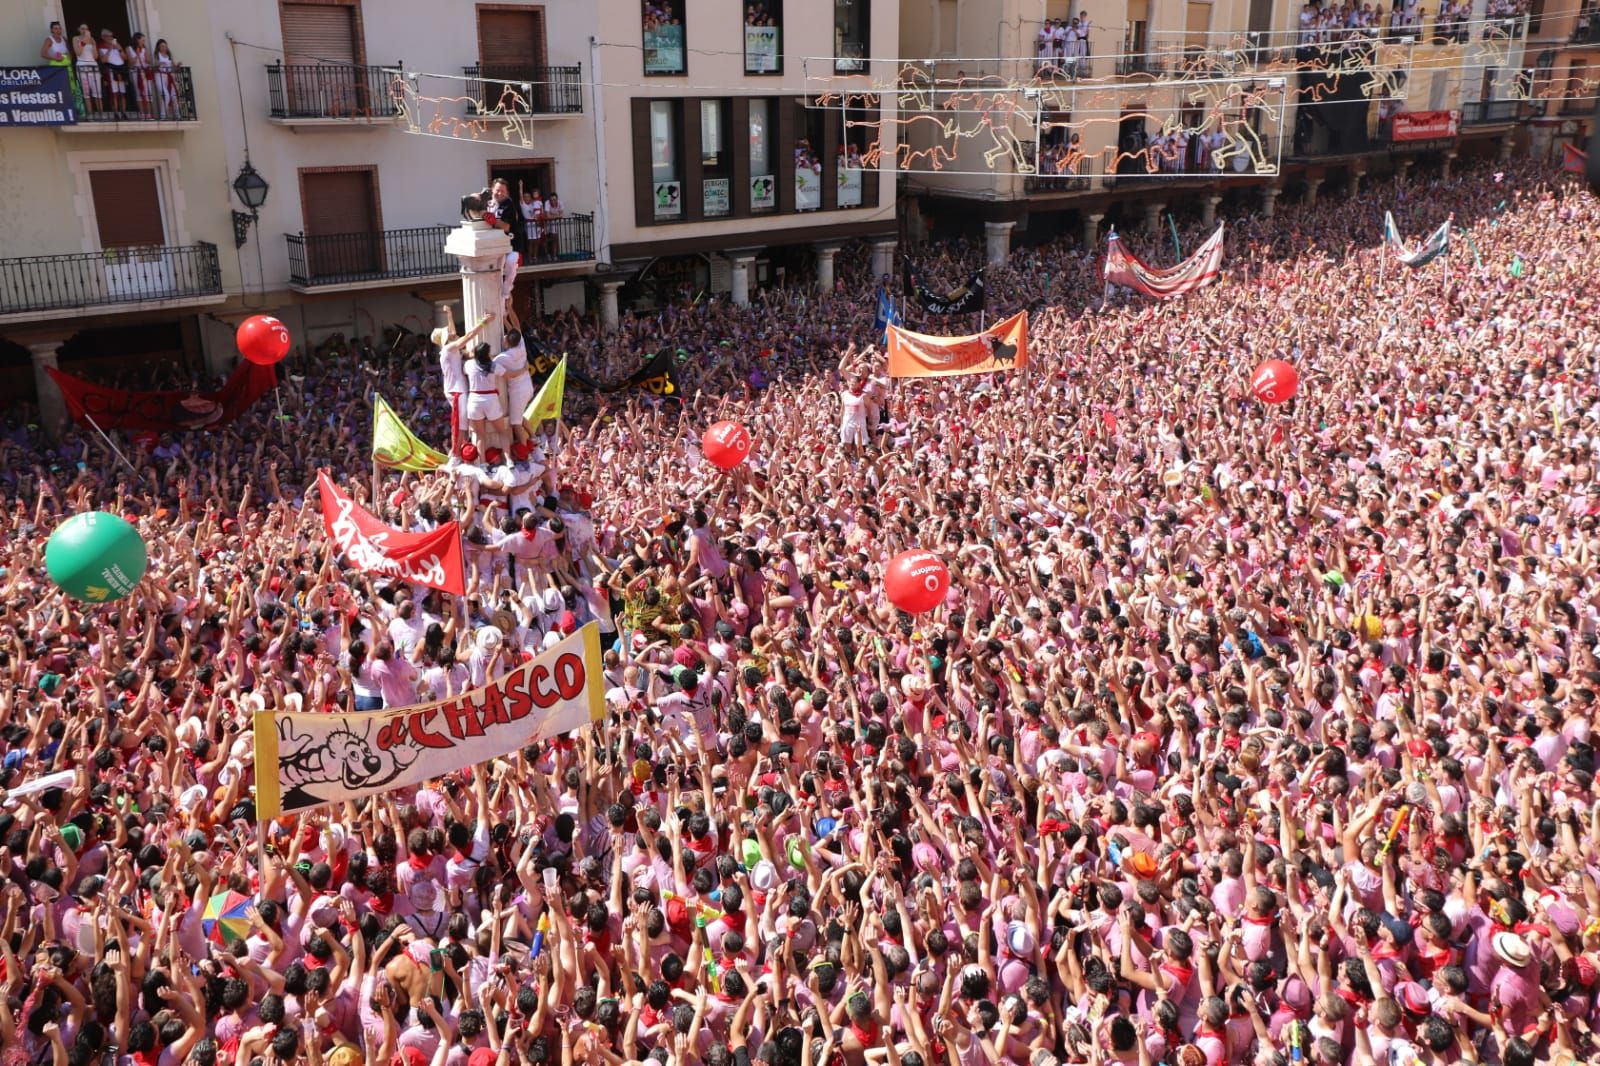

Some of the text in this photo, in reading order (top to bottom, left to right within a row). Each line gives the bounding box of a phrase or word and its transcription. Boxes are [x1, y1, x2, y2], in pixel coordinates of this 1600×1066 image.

[747, 32, 774, 43] DKV
[10, 91, 56, 105] Fiestas
[11, 109, 65, 123] Vaquilla
[376, 652, 586, 751] el CHASCO
